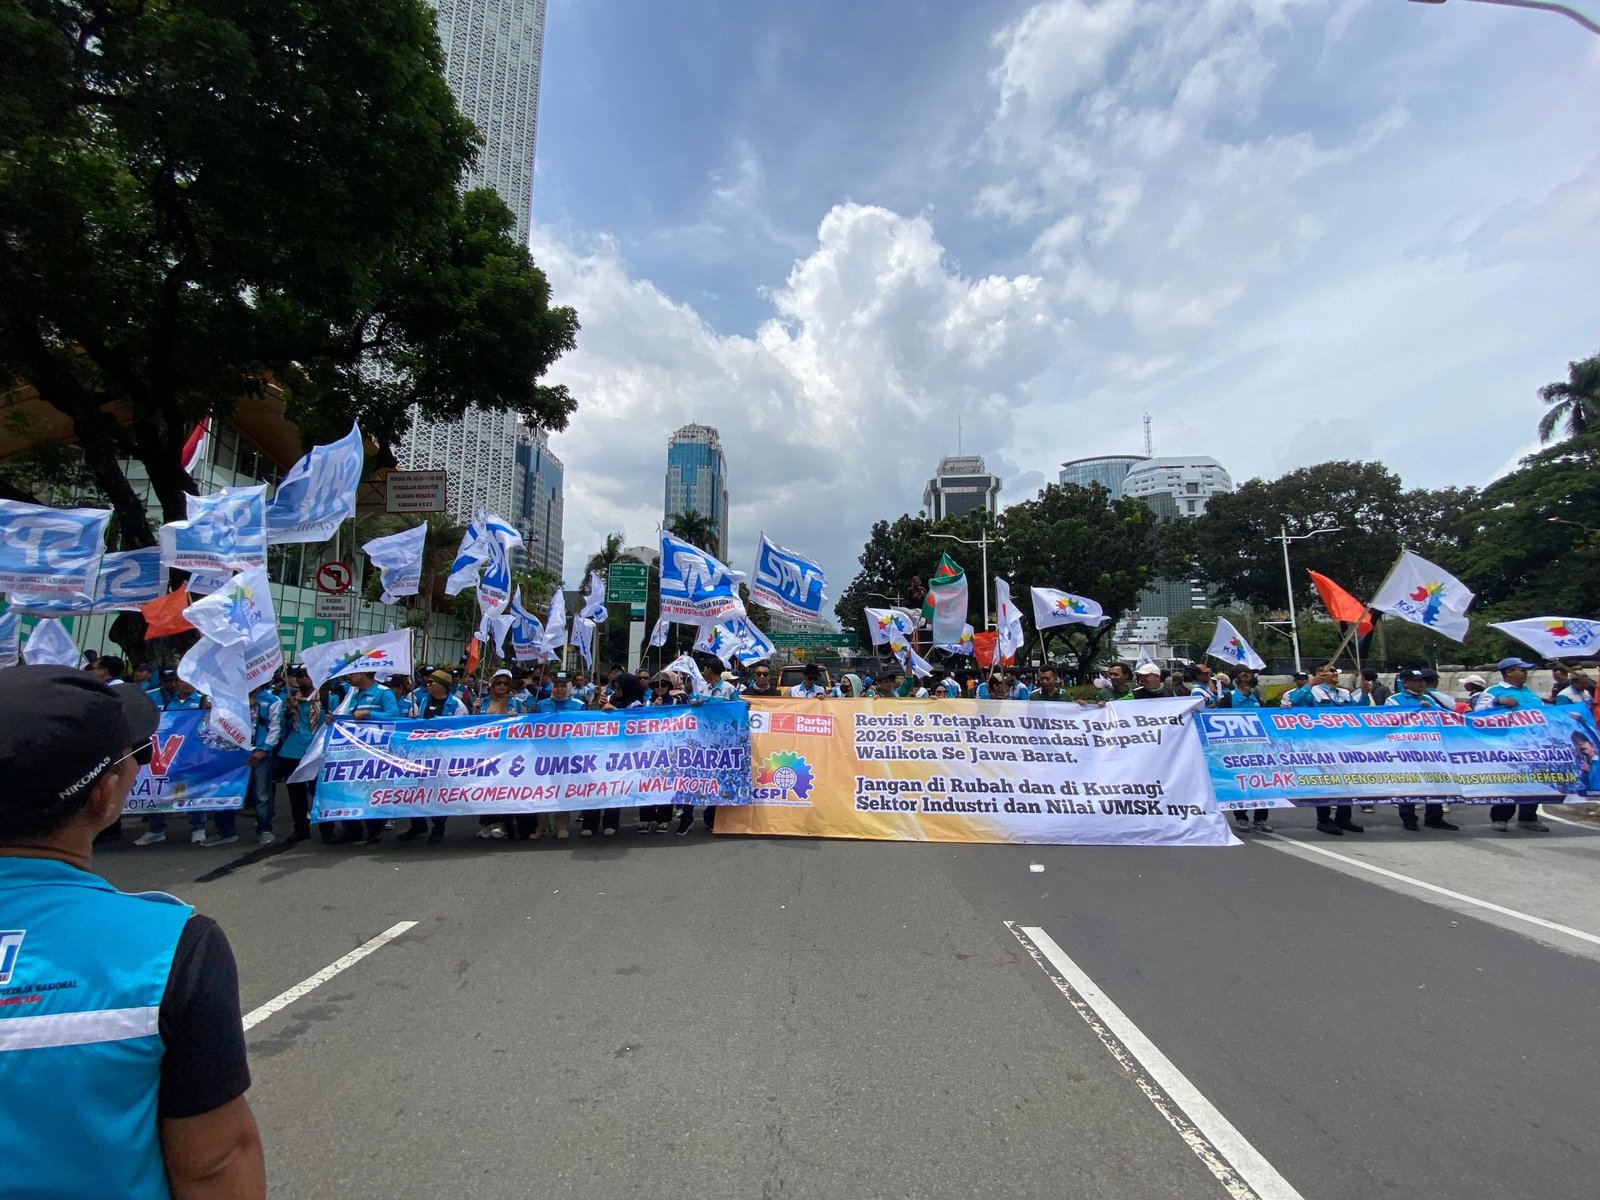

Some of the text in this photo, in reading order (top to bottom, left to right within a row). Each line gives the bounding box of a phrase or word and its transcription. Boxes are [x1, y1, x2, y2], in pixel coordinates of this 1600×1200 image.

[759, 550, 824, 603] SPN
[1554, 630, 1595, 647] KSPI
[507, 721, 619, 740] KABUPATEN
[625, 715, 697, 736] SERANG
[749, 713, 763, 730] 6
[796, 725, 832, 735] Buruh
[855, 713, 1185, 733] Revisi & Tetapkan UMSK Jawa Barat
[1206, 714, 1261, 738] SPN
[1271, 713, 1361, 730] DPC-SPN
[1361, 711, 1466, 728] KABUPATEN
[855, 728, 1162, 748] 2026 Sesuai Rekomendasi Bupati/
[1386, 732, 1441, 743] MENUNTUT
[855, 745, 1078, 763] Walikota Se Jawa Barat.
[1222, 748, 1574, 769] SEGERA SAHKAN UNDANG-UNDANG ETENAGAKERJAAN
[323, 747, 747, 784] TETAPKAN UMK & UMSK JAWA BARAT
[58, 755, 111, 800] NIKOMAS
[855, 776, 1164, 799] Jangan di Rubah dan di Kurangi
[1235, 771, 1578, 791] TOLAK SISTEM PENGUPAHAN YANG MISKINKAN PEKERJA
[370, 776, 720, 807] SESUAI REKOMENDASI BUPATI/ WALIKOTA
[751, 788, 787, 800] KSPI
[122, 799, 158, 810] OTA
[855, 796, 918, 812] Sektor
[922, 797, 999, 814] Industri
[1003, 798, 1042, 814] dan
[1046, 799, 1096, 815] Nilai
[1099, 800, 1164, 816] UMSK
[1166, 803, 1207, 821] nya.
[35, 980, 78, 992] NASIONAL
